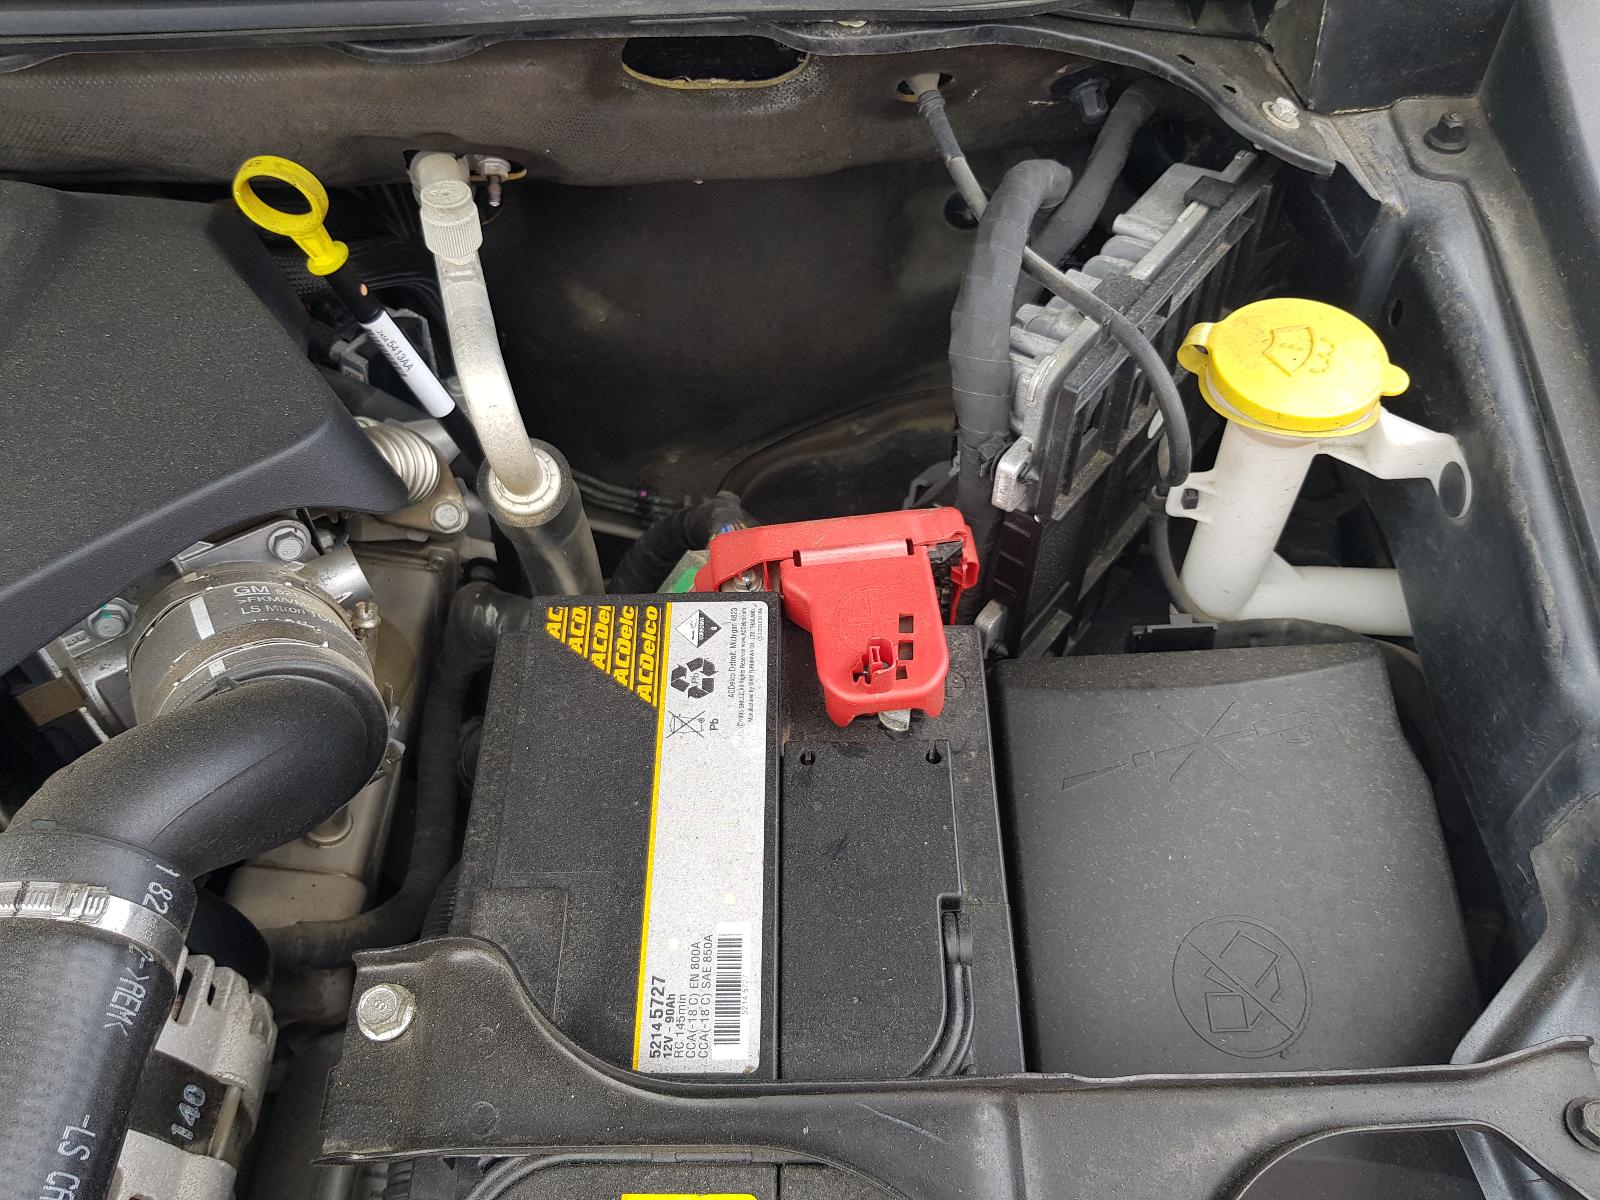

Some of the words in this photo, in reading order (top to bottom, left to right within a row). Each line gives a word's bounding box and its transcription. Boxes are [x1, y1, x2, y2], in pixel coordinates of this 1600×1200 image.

[234, 585, 270, 594] GM
[241, 605, 262, 615] LS
[266, 604, 306, 615] Mtron
[613, 606, 635, 687] ACDelc
[729, 623, 739, 648] Michigan
[637, 605, 658, 703] ACDelco
[690, 672, 700, 685] Pb
[727, 673, 736, 698] ACDelco
[709, 718, 719, 731] Pb
[690, 941, 701, 969] 800A
[703, 934, 713, 963] 850A
[690, 973, 699, 988] EN
[701, 966, 712, 988] SAE
[665, 993, 676, 1023] 90Ah
[675, 993, 687, 1037] 145min
[663, 1036, 673, 1058] 12V
[673, 1042, 684, 1058] RC
[171, 1084, 206, 1140] 140
